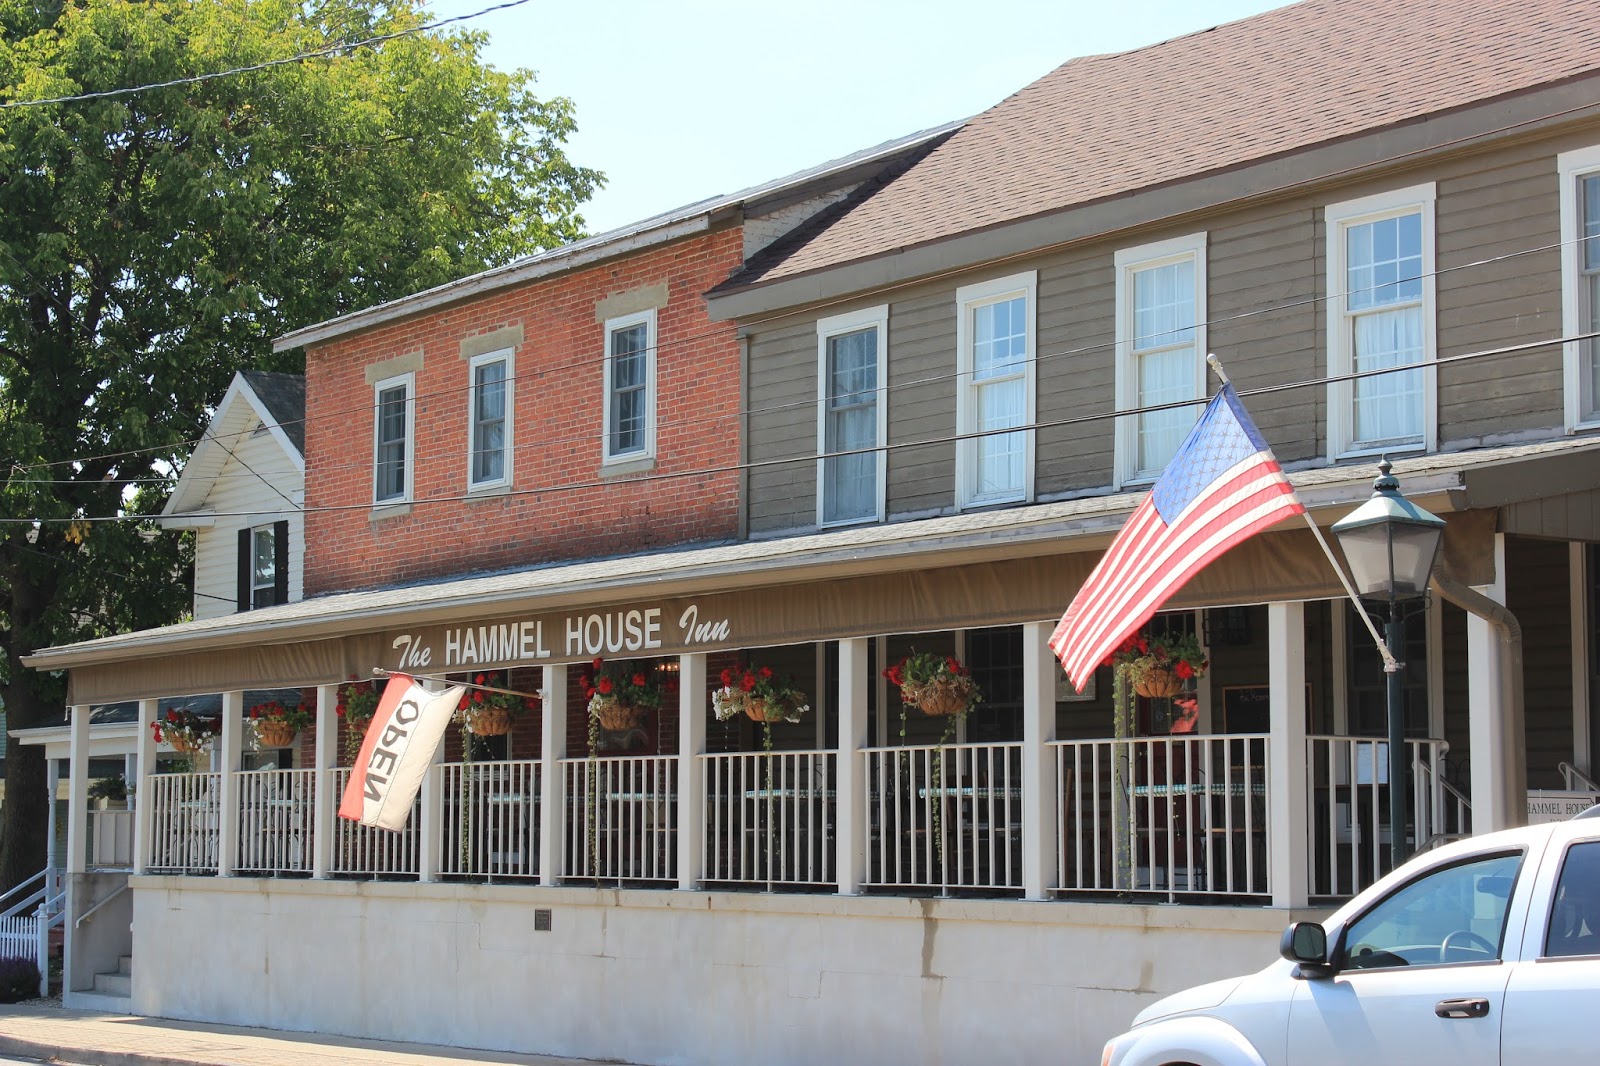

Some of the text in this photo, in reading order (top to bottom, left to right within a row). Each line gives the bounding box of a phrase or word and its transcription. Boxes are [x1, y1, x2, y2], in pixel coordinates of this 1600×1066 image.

[392, 604, 731, 670] The HAMMEL HOUSE Inn
